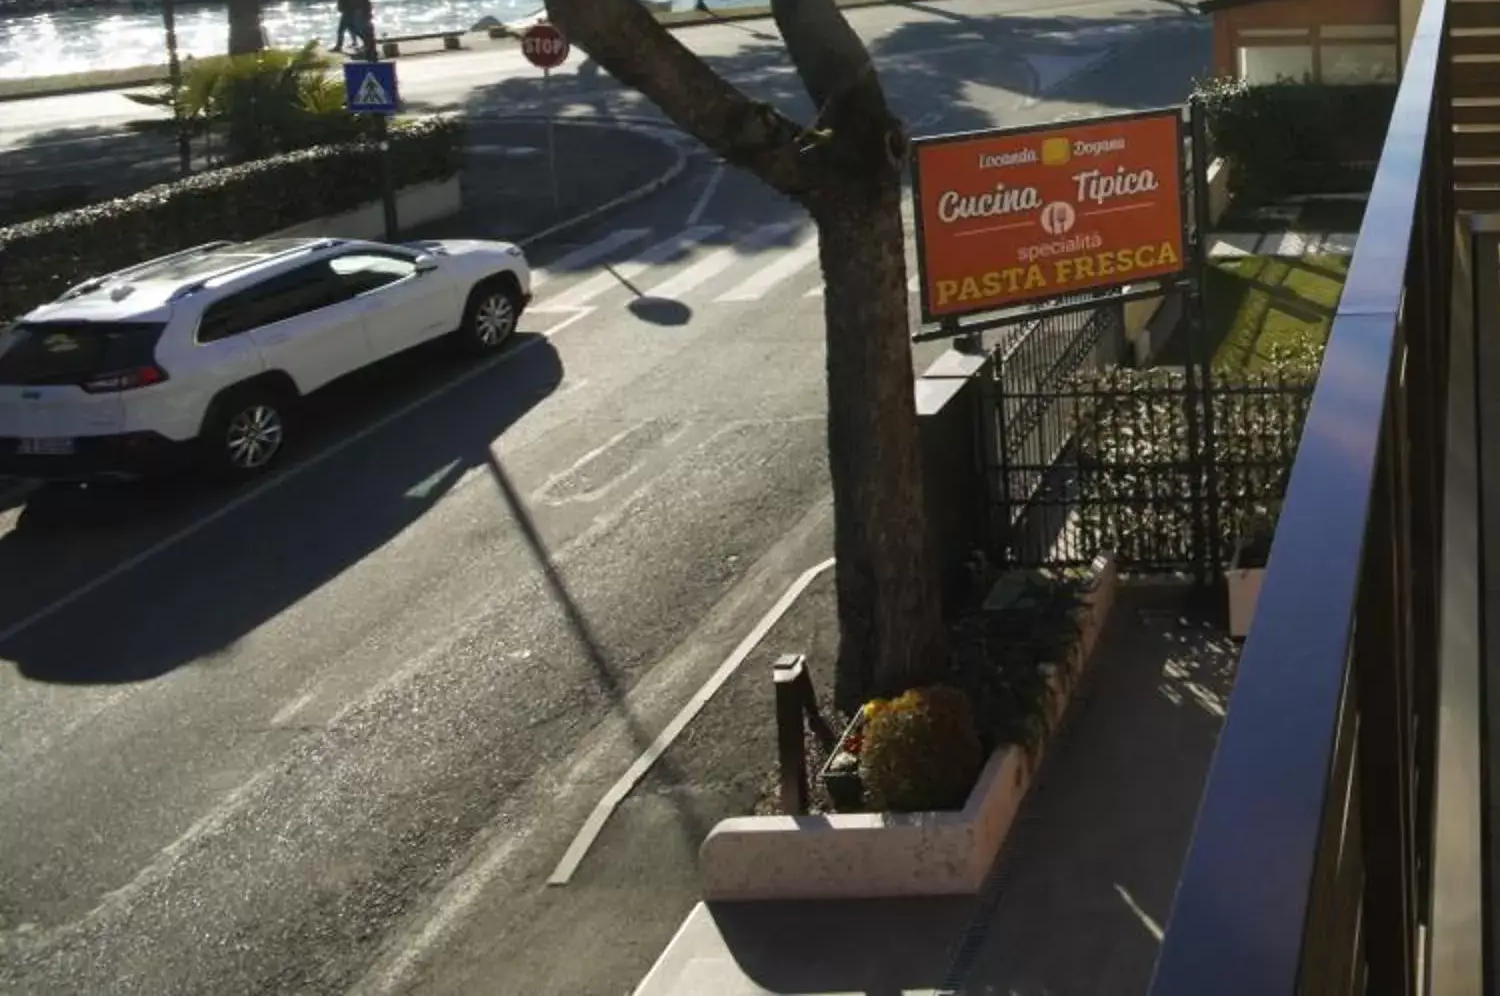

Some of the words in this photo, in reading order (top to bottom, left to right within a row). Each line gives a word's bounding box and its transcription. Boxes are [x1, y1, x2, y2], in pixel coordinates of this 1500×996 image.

[525, 37, 563, 55] STOP
[979, 147, 1037, 169] Locanda
[1073, 138, 1125, 158] Dogana
[938, 183, 1043, 223] Cucina
[1072, 166, 1159, 205] Tipica
[936, 262, 1046, 305] PASTA
[1054, 241, 1179, 284] FRESCA
